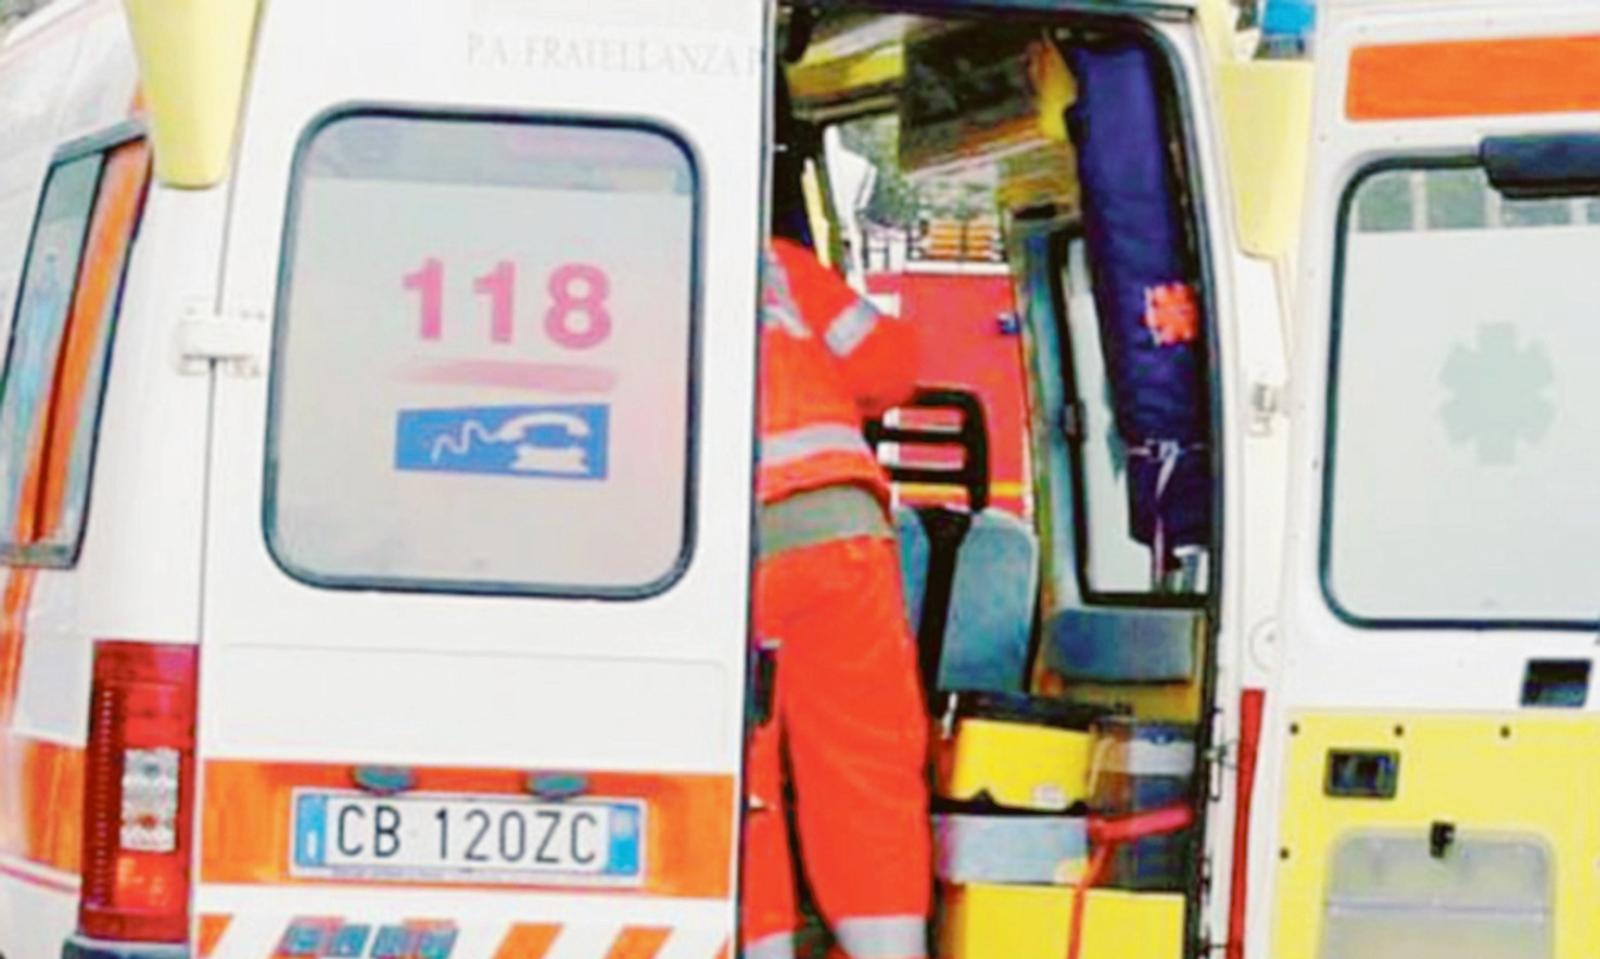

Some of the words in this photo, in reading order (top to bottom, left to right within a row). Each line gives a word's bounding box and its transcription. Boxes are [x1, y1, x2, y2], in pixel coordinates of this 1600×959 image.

[402, 257, 612, 350] 118
[337, 804, 401, 858] CB
[435, 806, 597, 865] 120ZC
